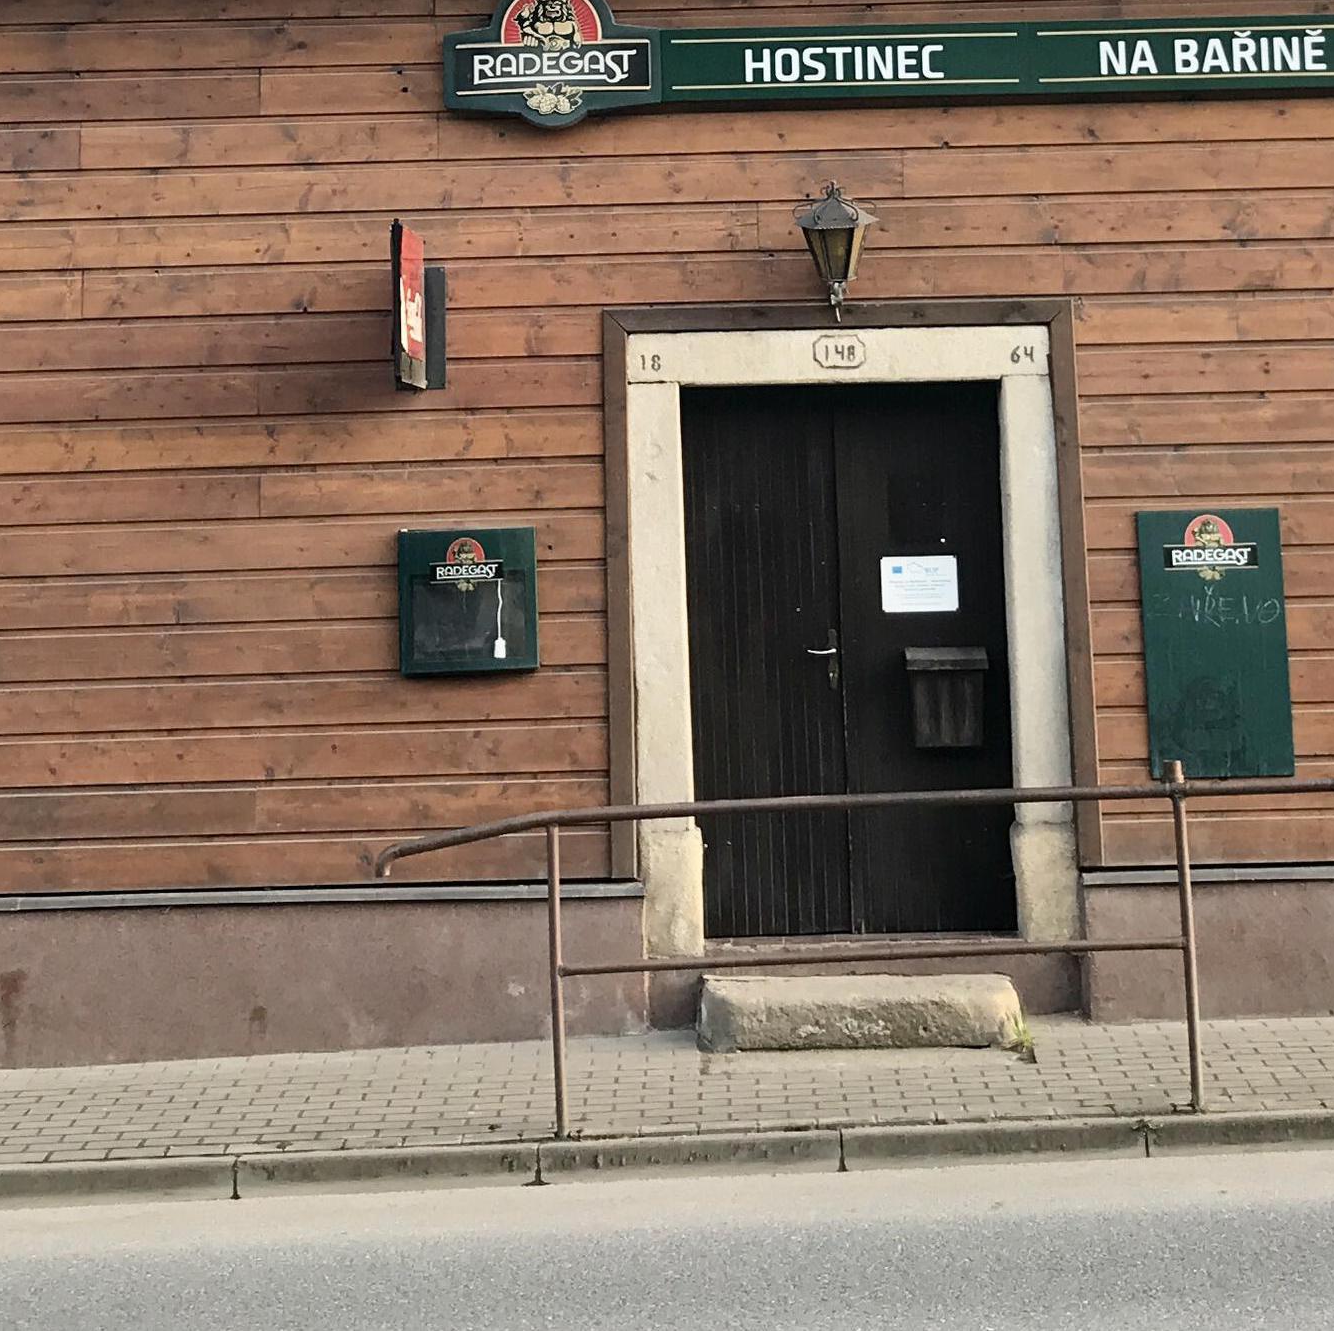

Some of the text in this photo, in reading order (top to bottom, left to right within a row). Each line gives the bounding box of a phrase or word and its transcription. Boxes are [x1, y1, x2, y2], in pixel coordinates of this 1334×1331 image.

[745, 29, 1327, 82] HOSTINEC NA BAŘINĚ
[473, 49, 637, 85] RADEGAST
[825, 345, 855, 361] 148
[1010, 345, 1034, 364] 64
[640, 354, 661, 372] 18
[1171, 547, 1251, 566] RADEGAST
[436, 564, 498, 580] RADEGAST
